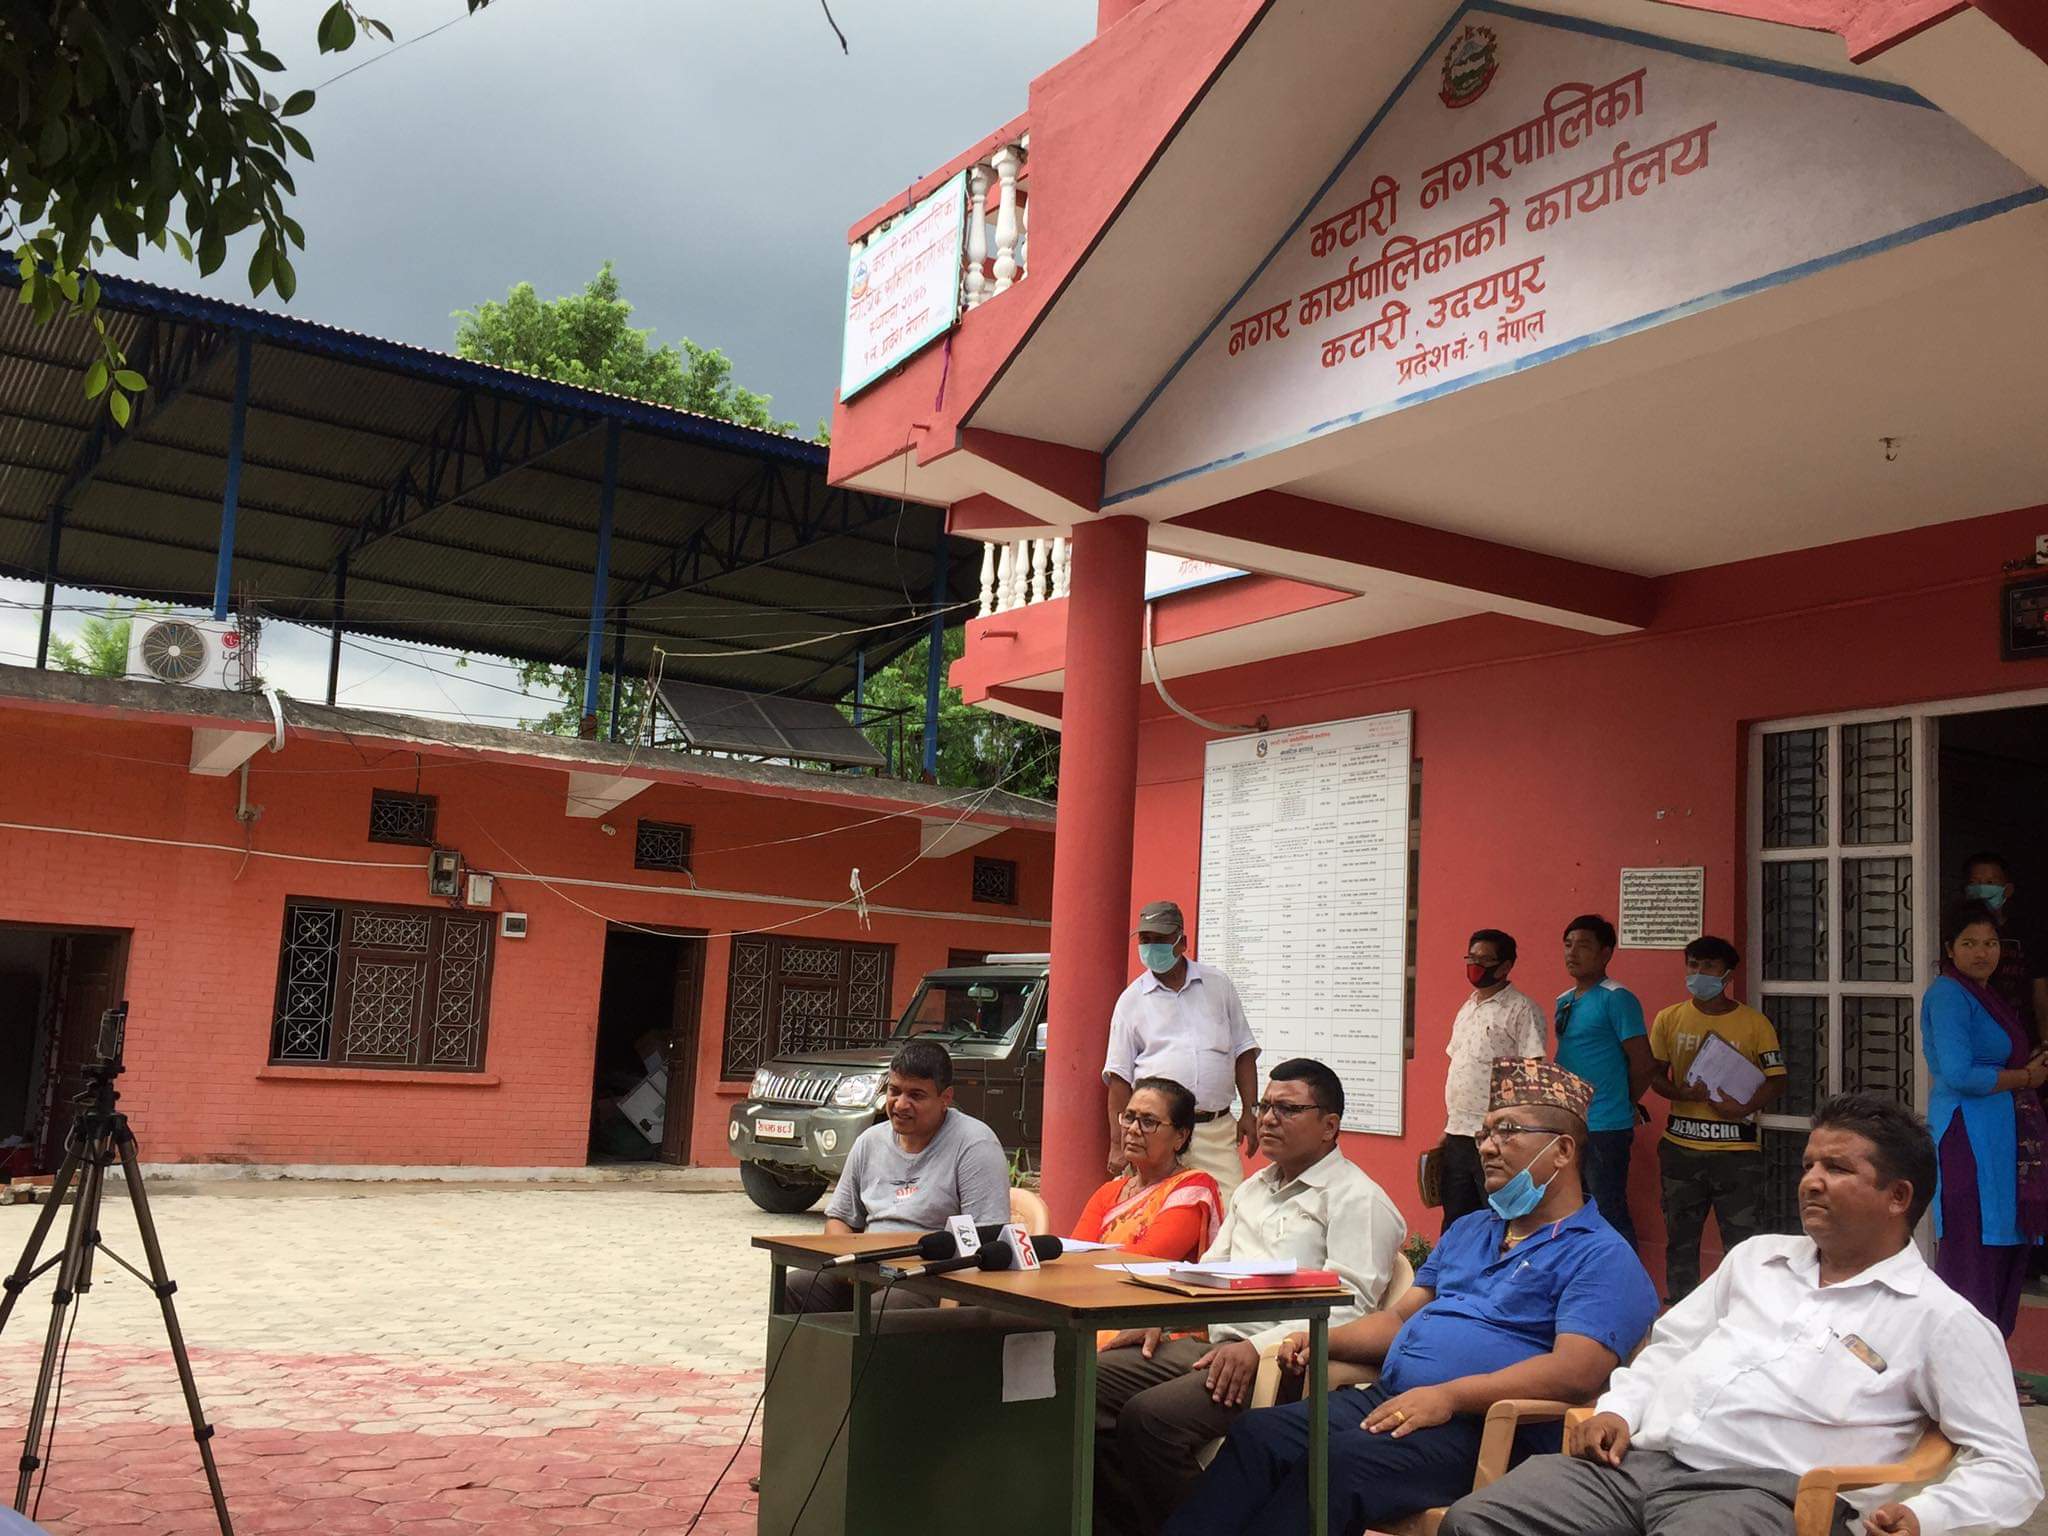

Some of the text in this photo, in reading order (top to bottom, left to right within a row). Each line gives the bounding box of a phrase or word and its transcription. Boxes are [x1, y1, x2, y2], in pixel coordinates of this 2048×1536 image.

[1310, 68, 1647, 257] कटारी नगरपालिका
[1229, 122, 1717, 357] नगर कार्यपालिकाको कार्यालय
[1426, 256, 1546, 330] उदयपुर
[1396, 343, 1450, 385] प्रदेश
[1496, 310, 1547, 347] नेपाल
